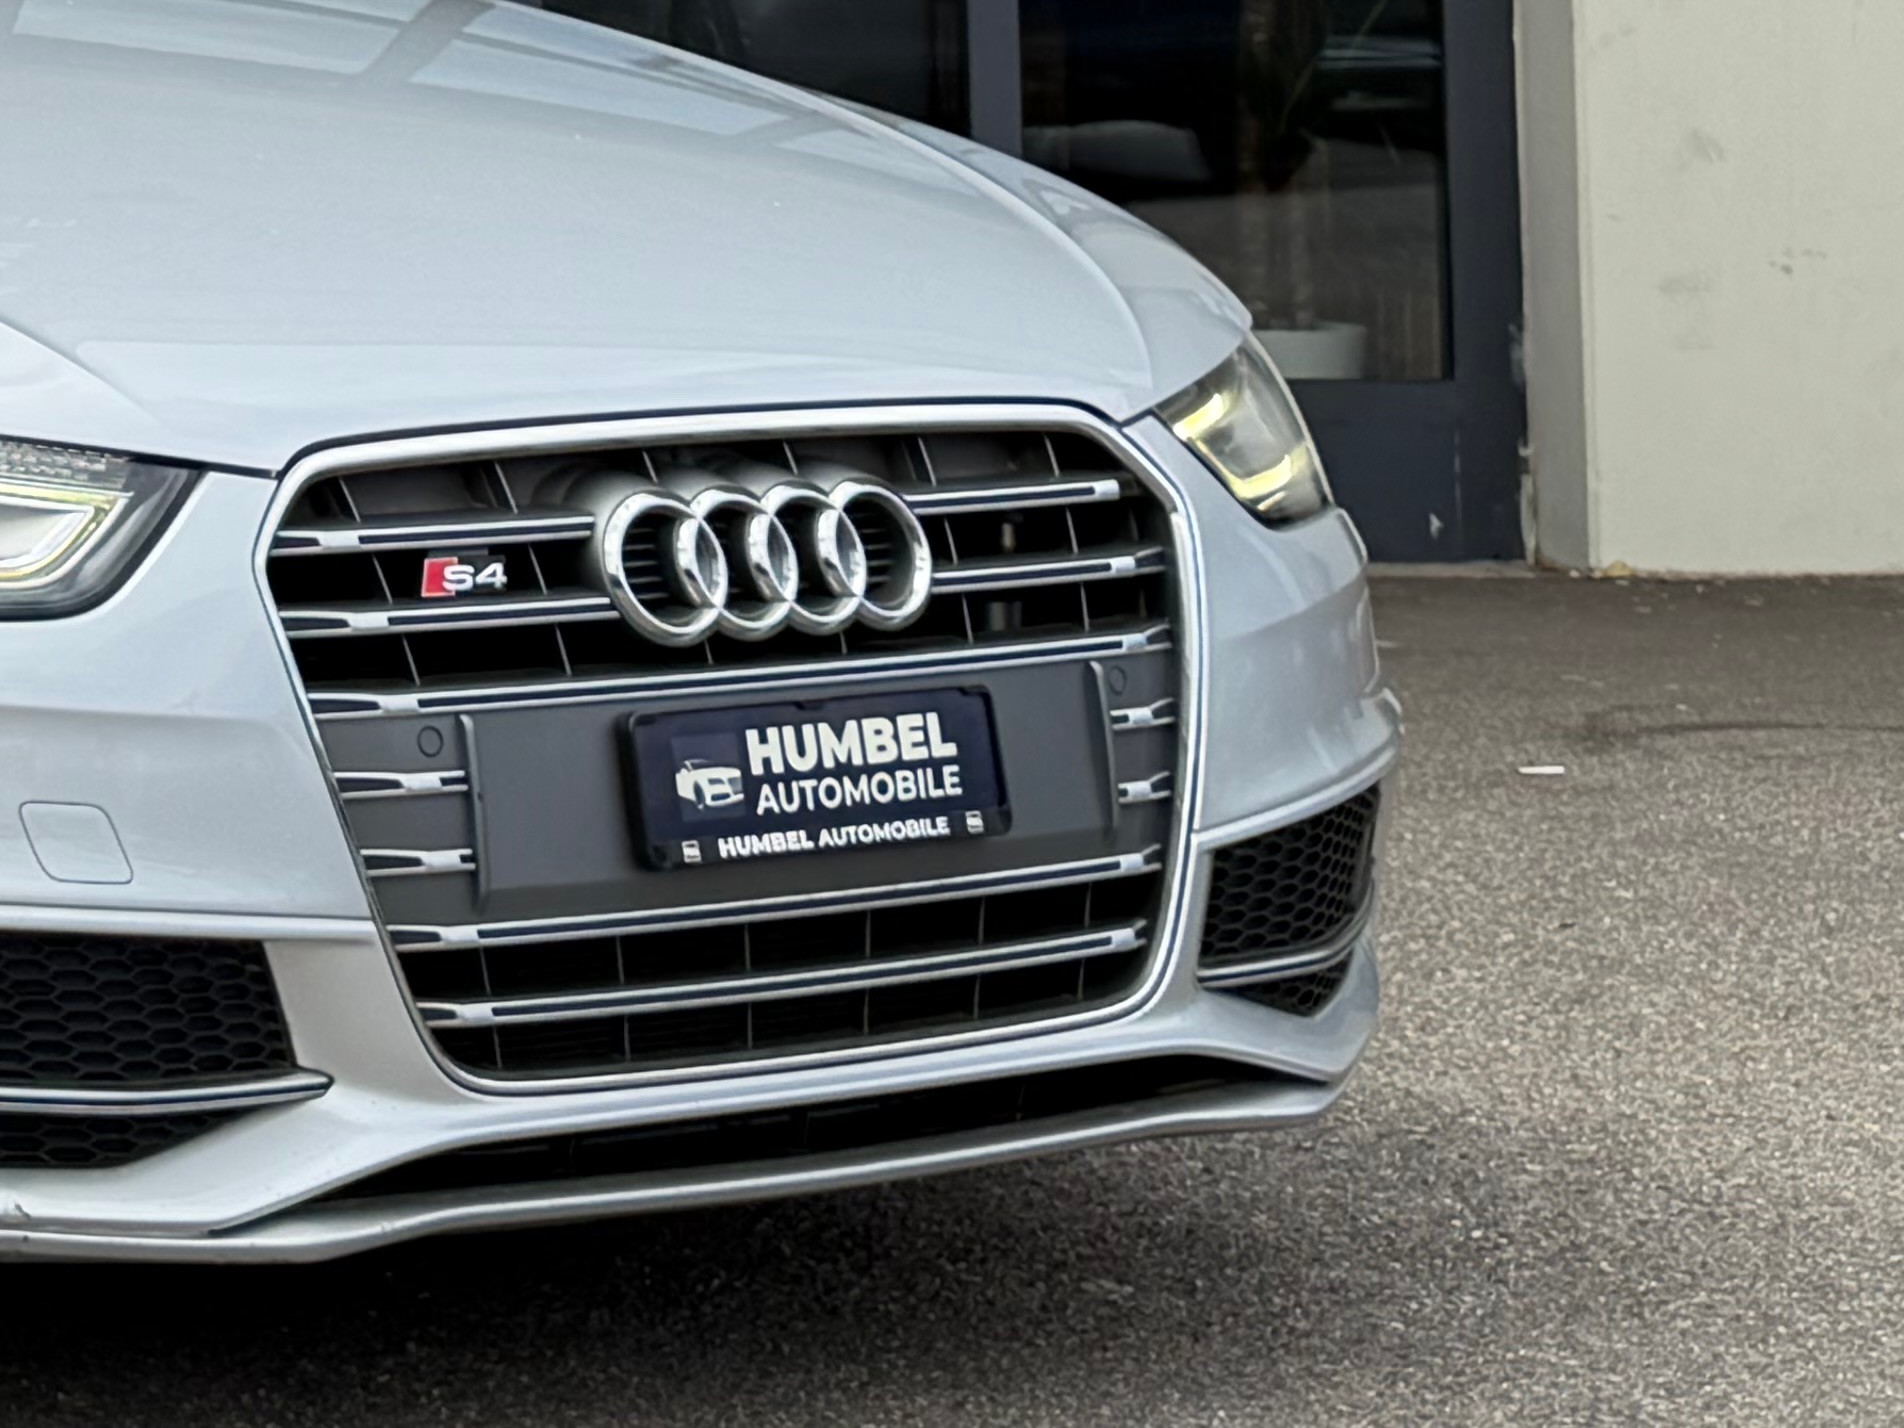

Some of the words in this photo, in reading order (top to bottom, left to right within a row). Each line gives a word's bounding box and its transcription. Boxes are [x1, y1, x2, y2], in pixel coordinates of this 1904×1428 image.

[442, 561, 508, 592] S4
[744, 711, 958, 776] HUMBEL
[755, 765, 963, 816] AUTOMOBILE
[717, 830, 815, 860] HUMBEL
[817, 815, 950, 849] AUTOMOBILE
